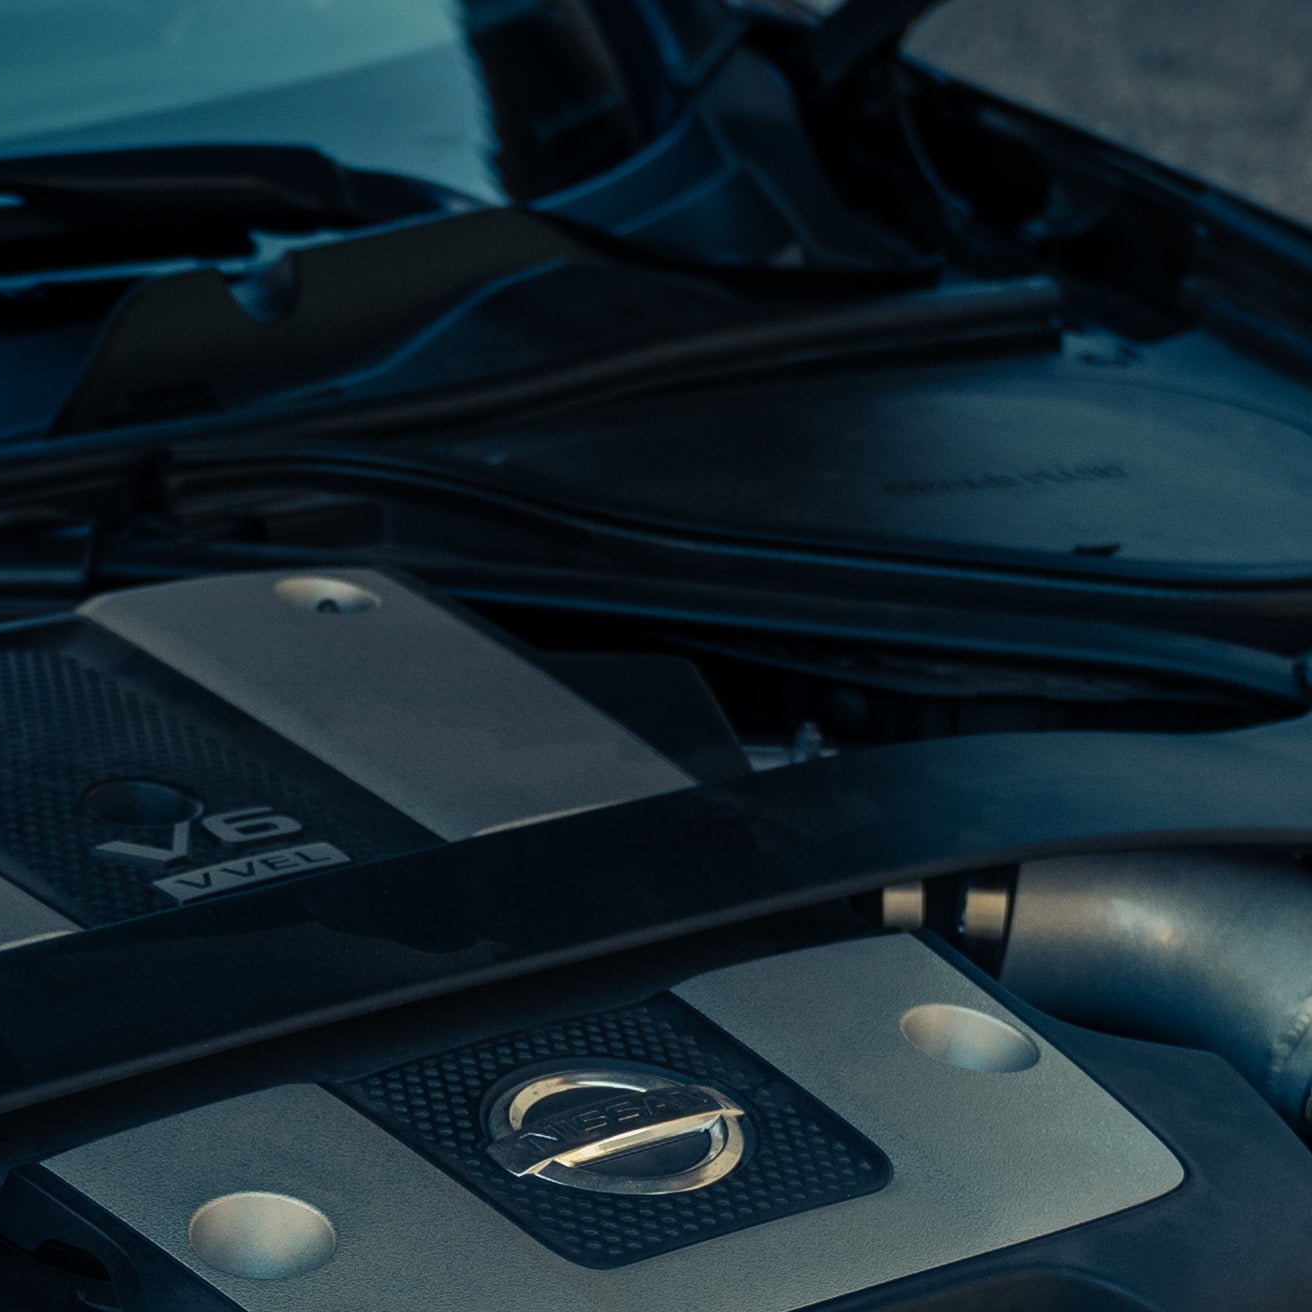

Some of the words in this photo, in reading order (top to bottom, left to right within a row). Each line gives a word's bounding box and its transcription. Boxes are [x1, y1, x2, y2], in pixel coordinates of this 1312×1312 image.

[95, 806, 303, 863] V6
[175, 850, 331, 890] VVEL
[519, 1090, 707, 1153] NISSAN
